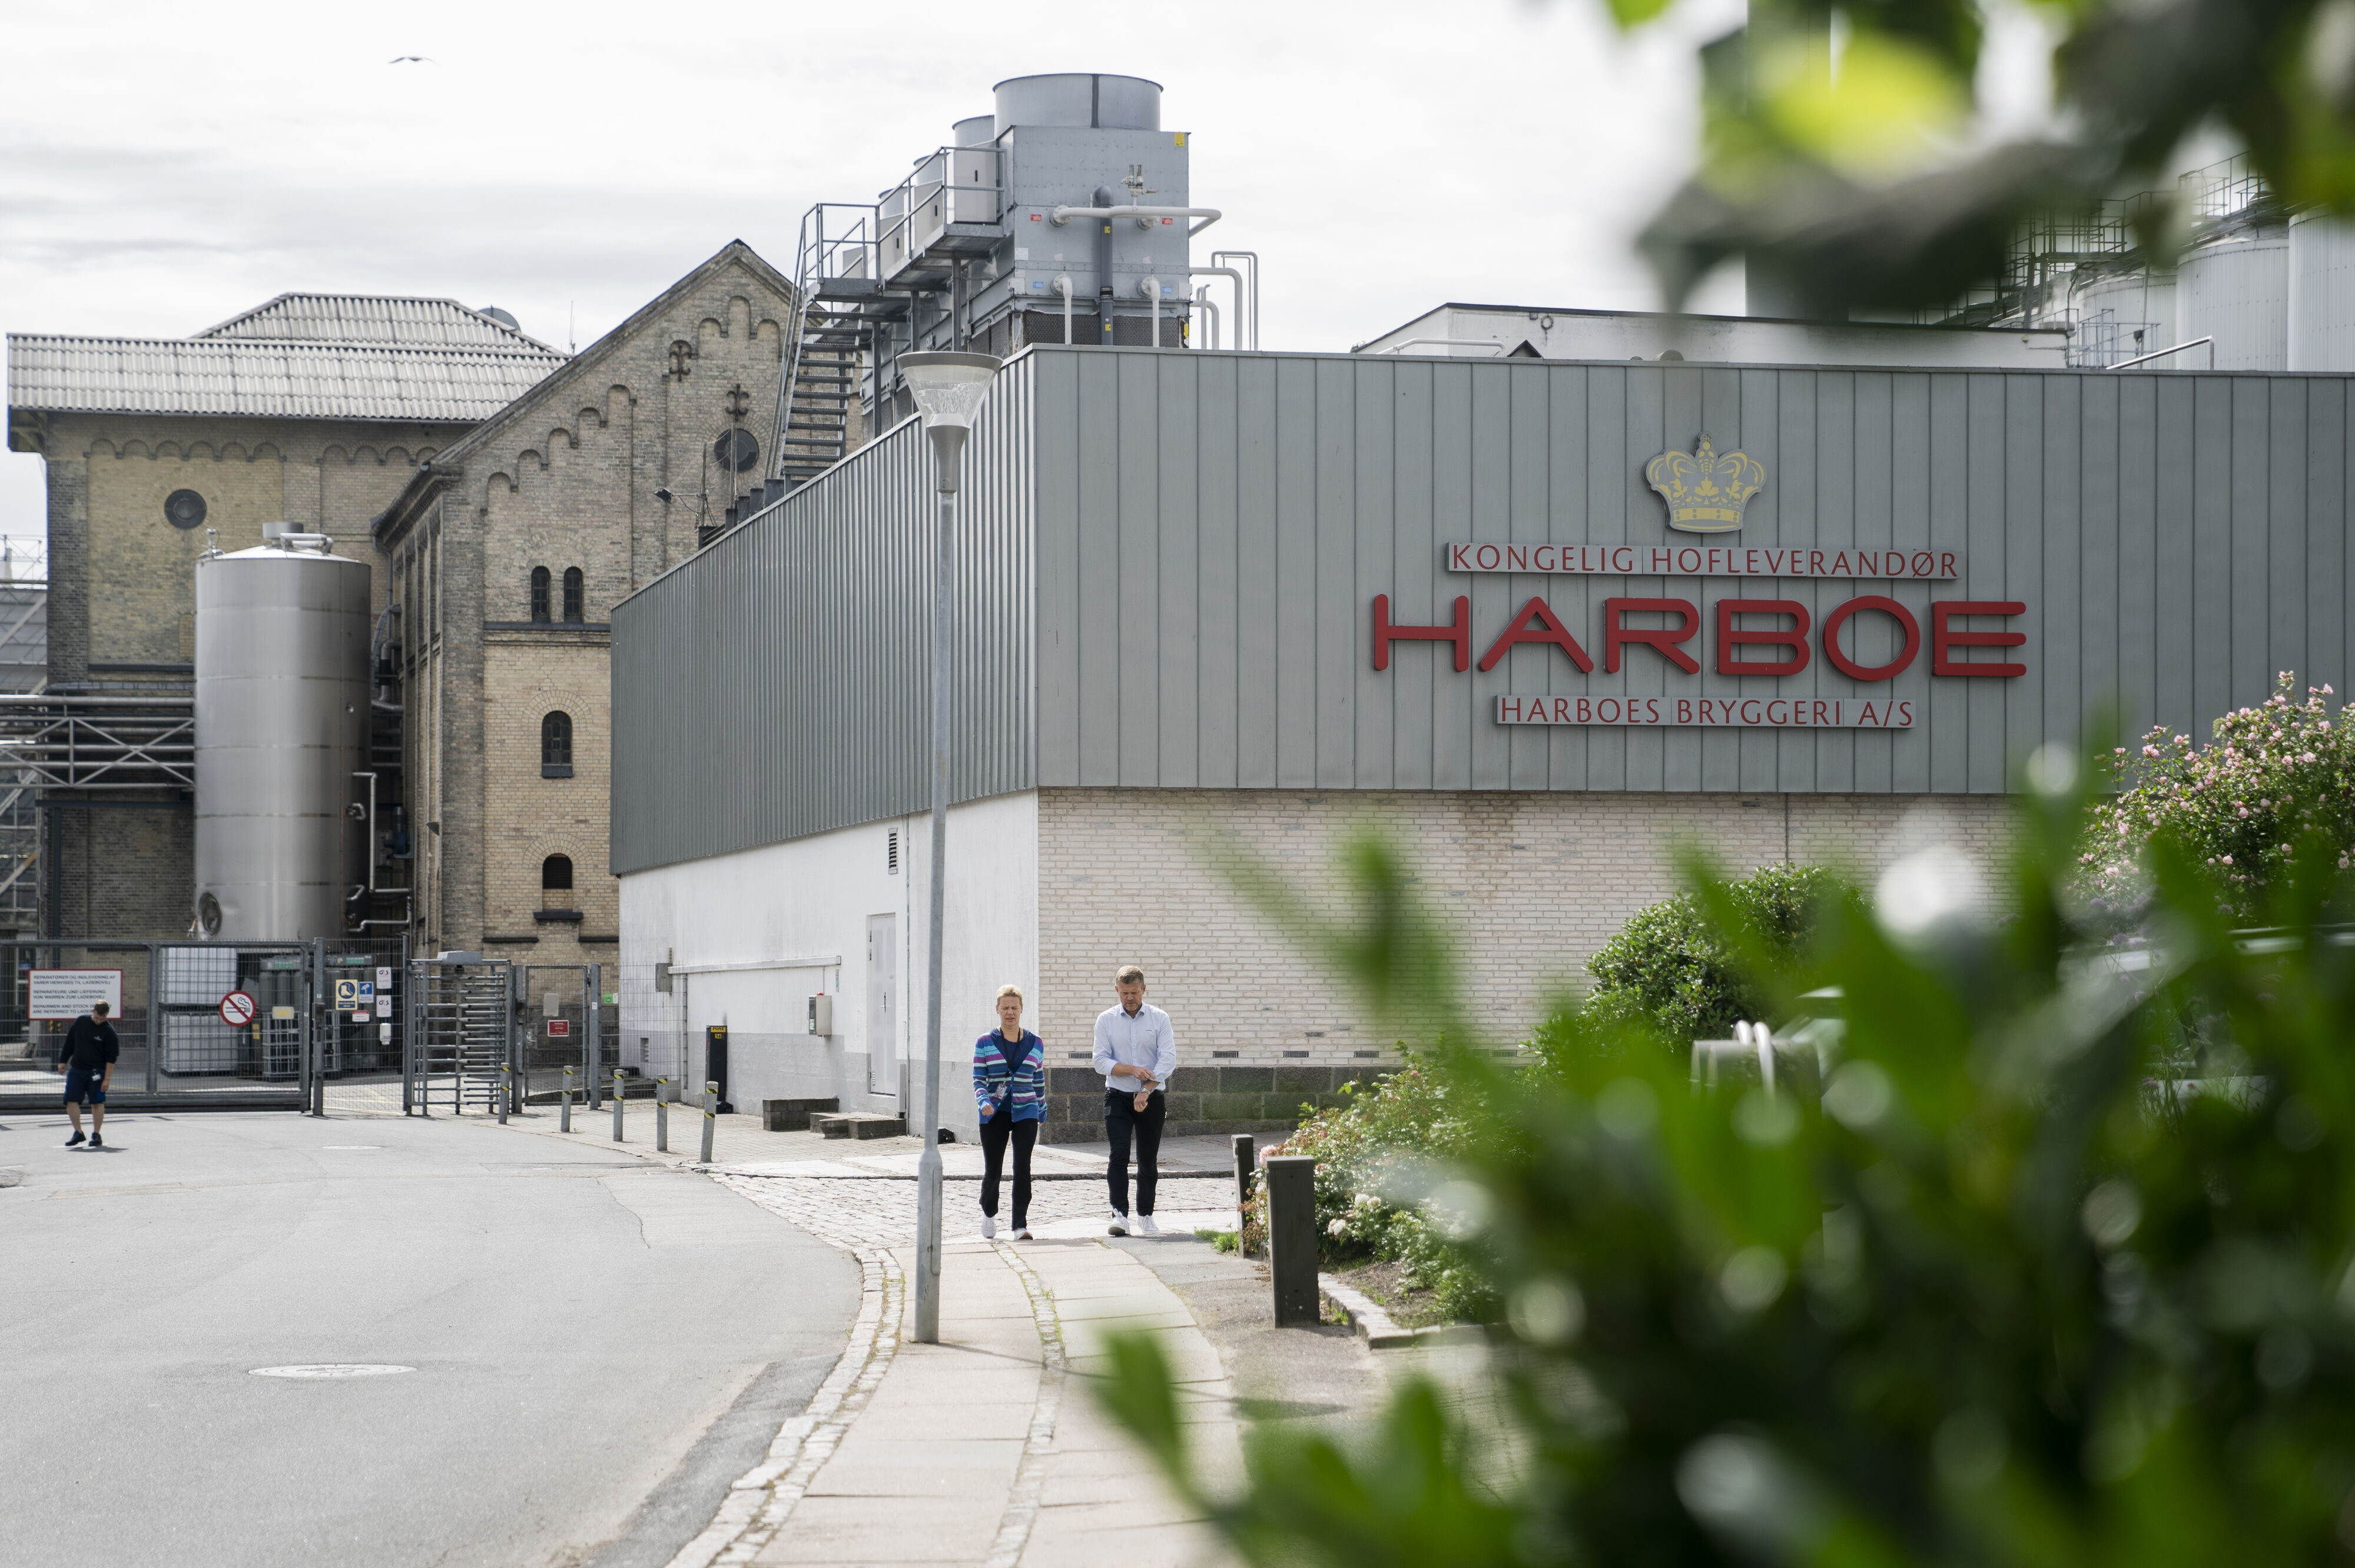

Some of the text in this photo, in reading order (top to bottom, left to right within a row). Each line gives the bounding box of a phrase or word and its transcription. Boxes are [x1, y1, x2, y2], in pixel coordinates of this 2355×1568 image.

[1454, 545, 1956, 577] KONGELIG HOFLEVERANDØR
[1373, 593, 2027, 681] HARBOE
[1501, 697, 1912, 727] HARBOES BRYGGERI A/S
